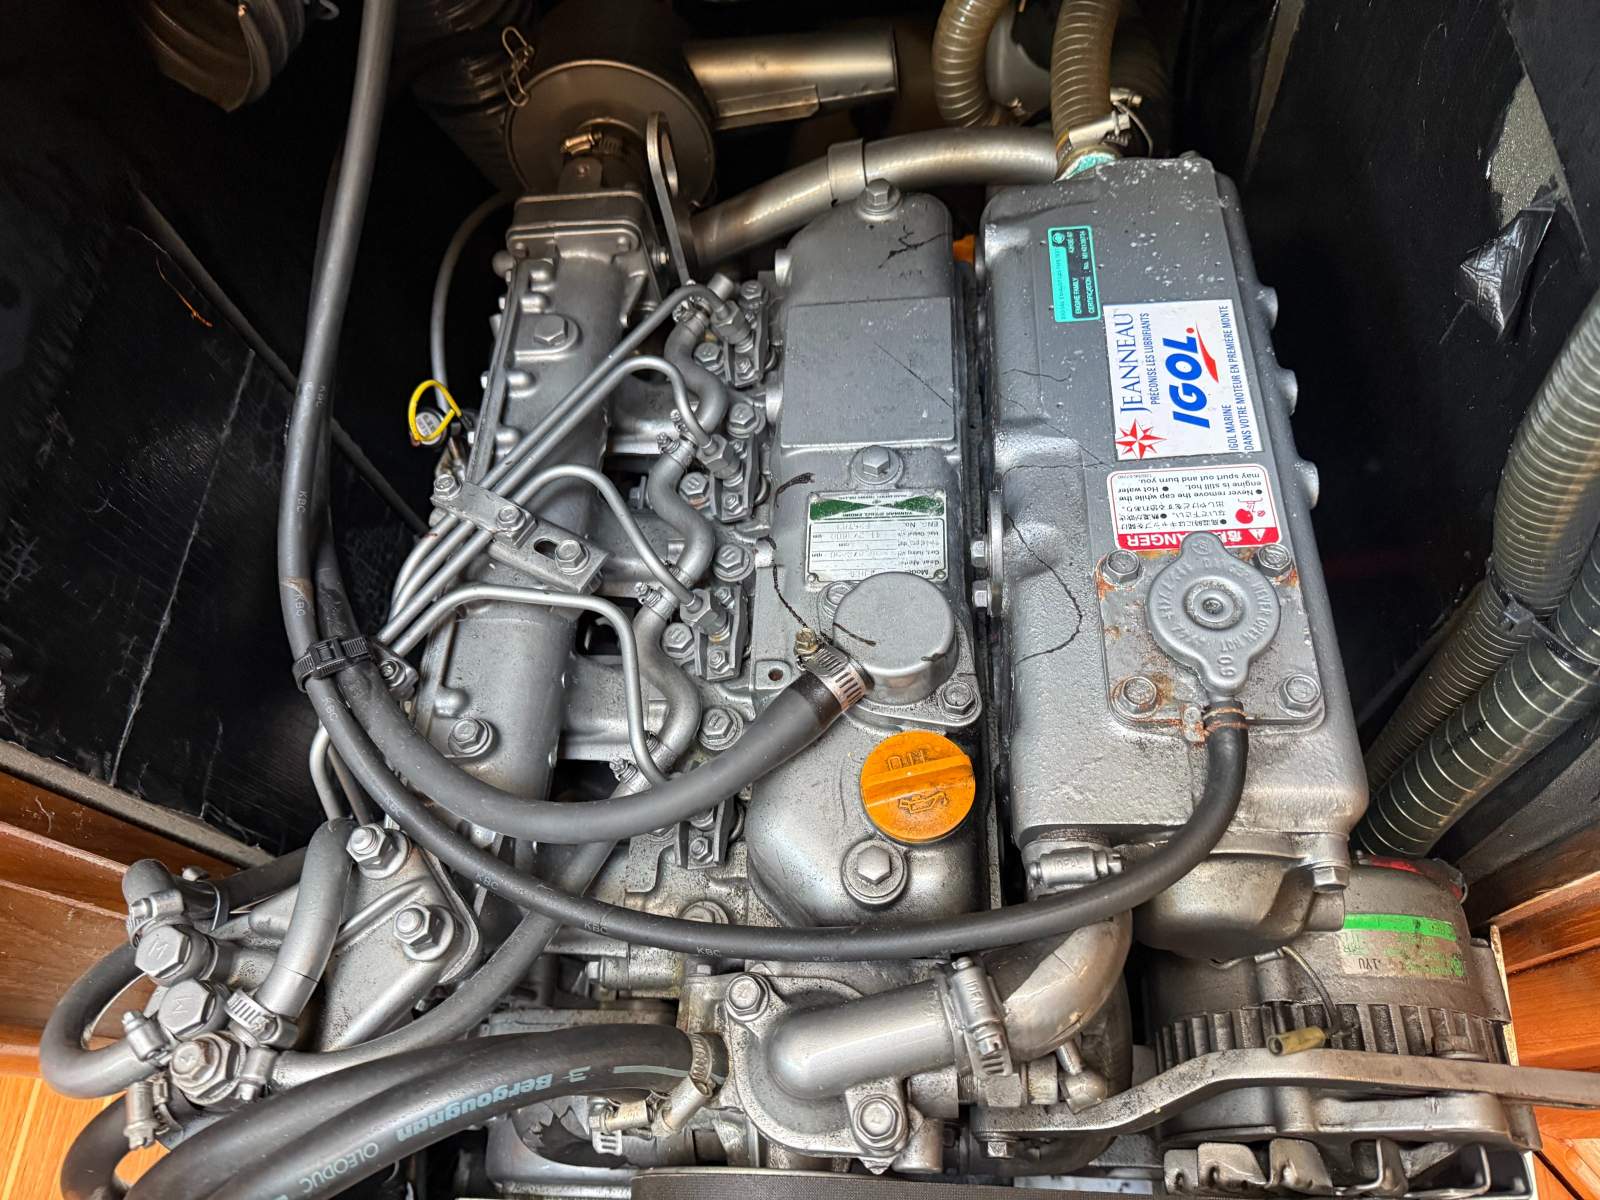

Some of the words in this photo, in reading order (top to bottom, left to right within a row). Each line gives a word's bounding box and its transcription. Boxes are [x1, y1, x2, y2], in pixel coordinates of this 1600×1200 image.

[1218, 305, 1231, 329] MONTE
[1139, 312, 1155, 353] LUBRIFIANTS
[1113, 312, 1153, 414] JEANNEAU
[1145, 354, 1156, 366] LES
[1228, 364, 1239, 374] EN
[1231, 374, 1245, 404] MOTEUR
[1221, 404, 1236, 433] MARINE
[1237, 406, 1249, 429] VOTRE
[1227, 434, 1239, 451] IGOL
[1243, 430, 1254, 451] DANS
[1127, 533, 1187, 547] ANGER
[295, 594, 305, 617] KBC
[475, 872, 499, 889] KBC
[584, 922, 608, 934] KBC
[696, 946, 721, 957] KBC
[396, 1073, 553, 1142] Bergougnan
[298, 1142, 380, 1192] OLEODUC
